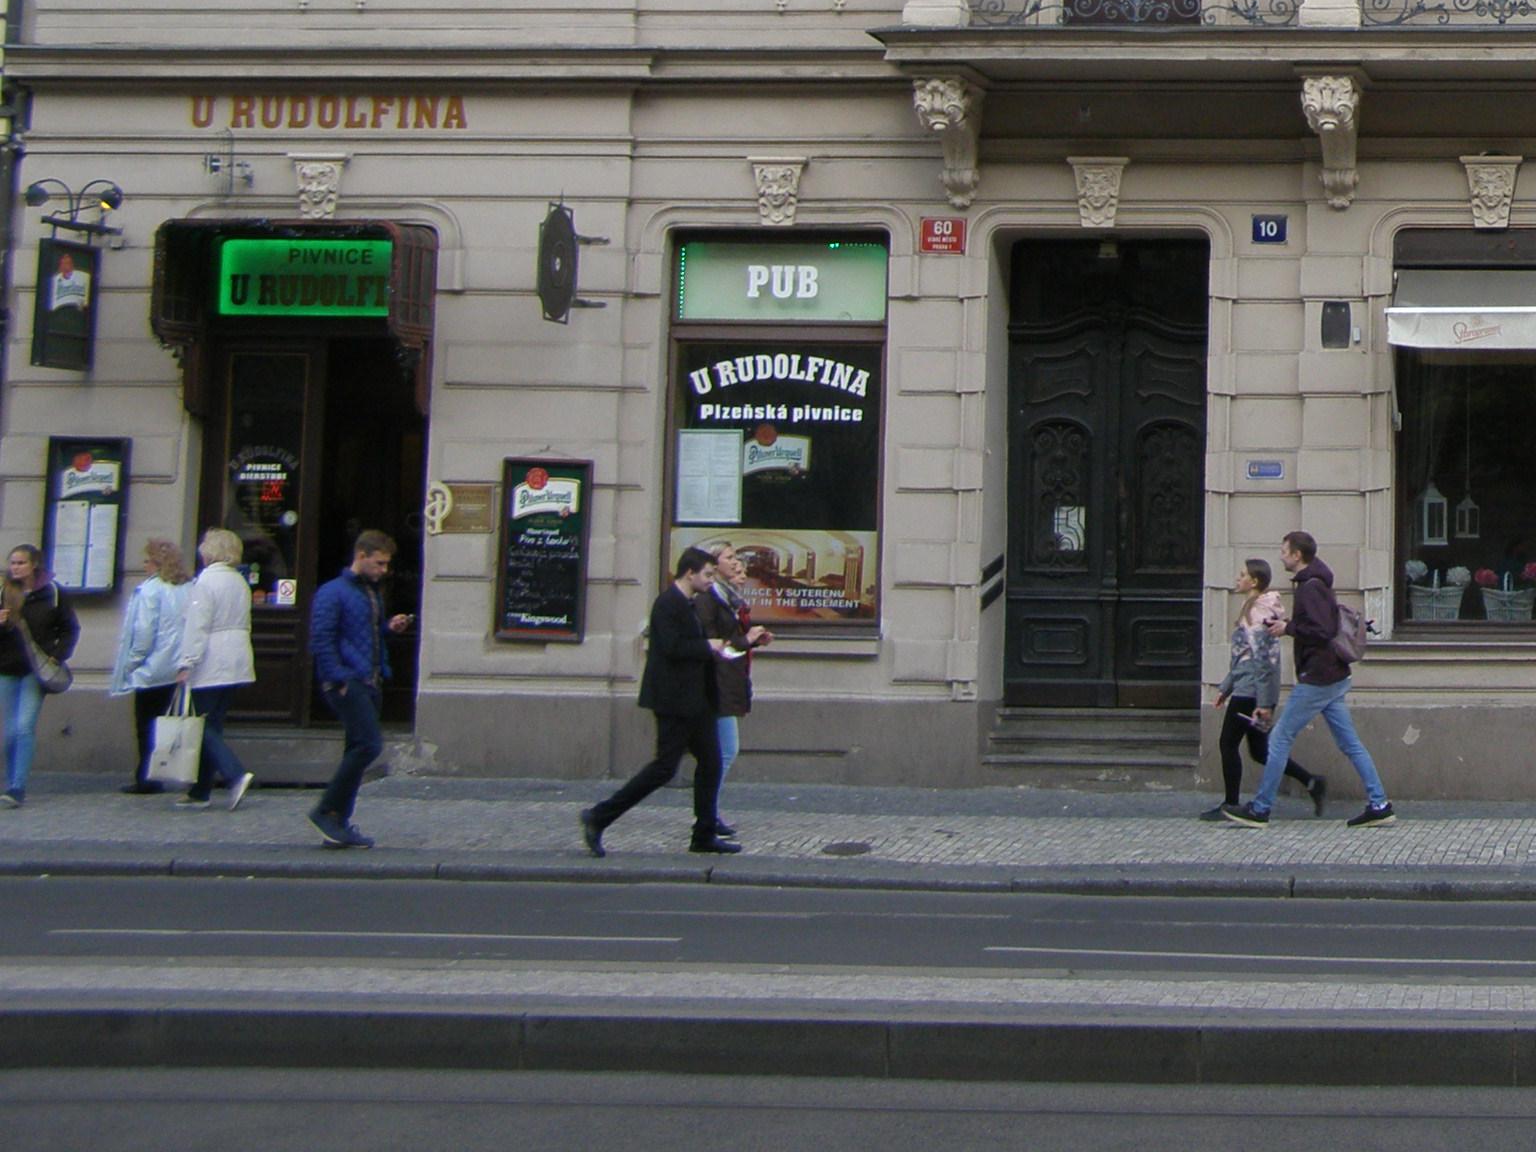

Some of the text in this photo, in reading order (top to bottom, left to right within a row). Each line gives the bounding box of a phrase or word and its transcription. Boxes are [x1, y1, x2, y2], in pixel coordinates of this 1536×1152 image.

[192, 96, 467, 129] U RUDOLFINA
[934, 221, 952, 235] 60
[1260, 221, 1278, 237] 10
[288, 249, 373, 265] PIVNICE
[231, 274, 250, 305] U
[747, 265, 818, 298] PUB
[690, 353, 870, 397] U RUDOLFINA
[700, 403, 862, 422] Plzeňská pivnice
[775, 588, 784, 597] V
[760, 598, 772, 607] IN
[776, 598, 797, 607] THE
[800, 599, 860, 608] BASEMENT
